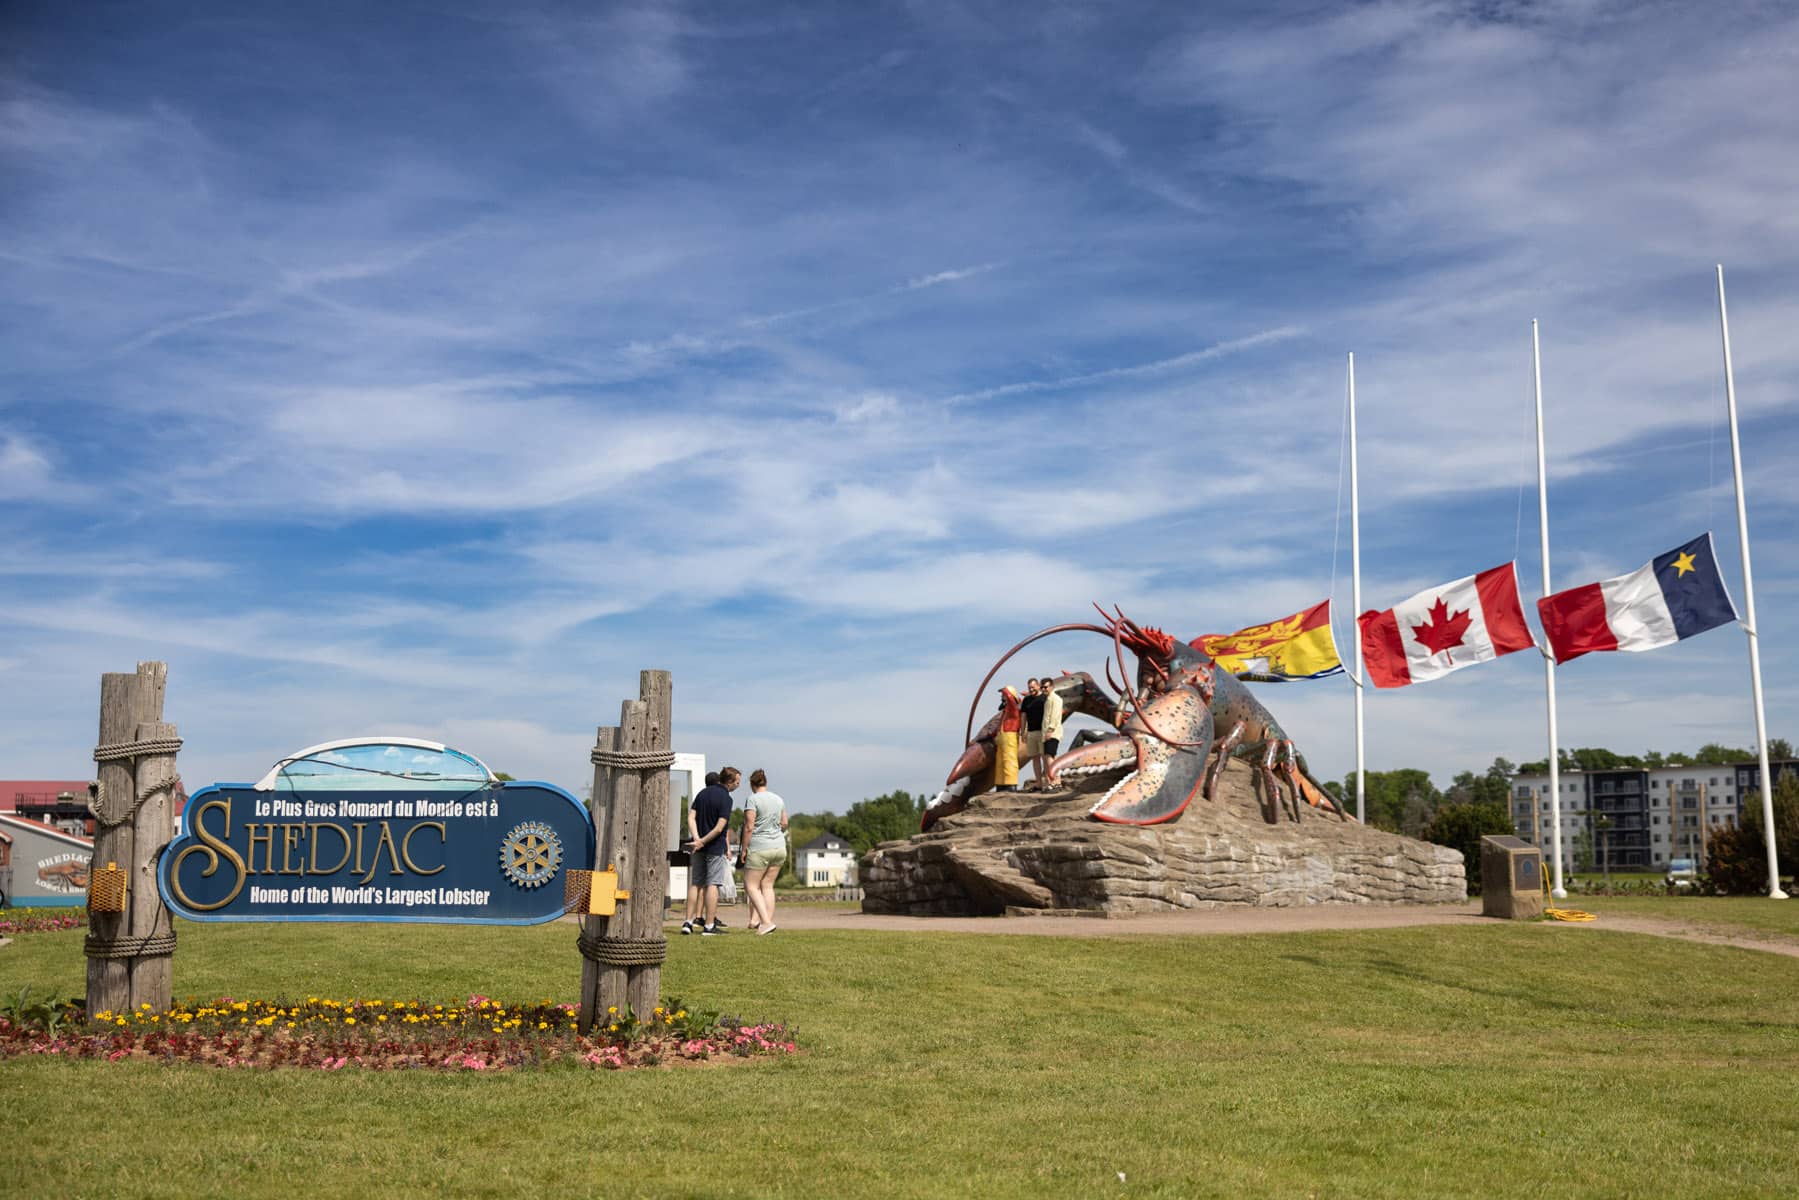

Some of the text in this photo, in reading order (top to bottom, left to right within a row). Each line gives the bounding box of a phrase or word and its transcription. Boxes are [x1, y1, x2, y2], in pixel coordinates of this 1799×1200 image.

[255, 799, 499, 817] Le Plus Gros Homard du Monde est à
[171, 797, 446, 911] SHEDIAC
[250, 886, 490, 906] Home of the World's Largest Lobster
